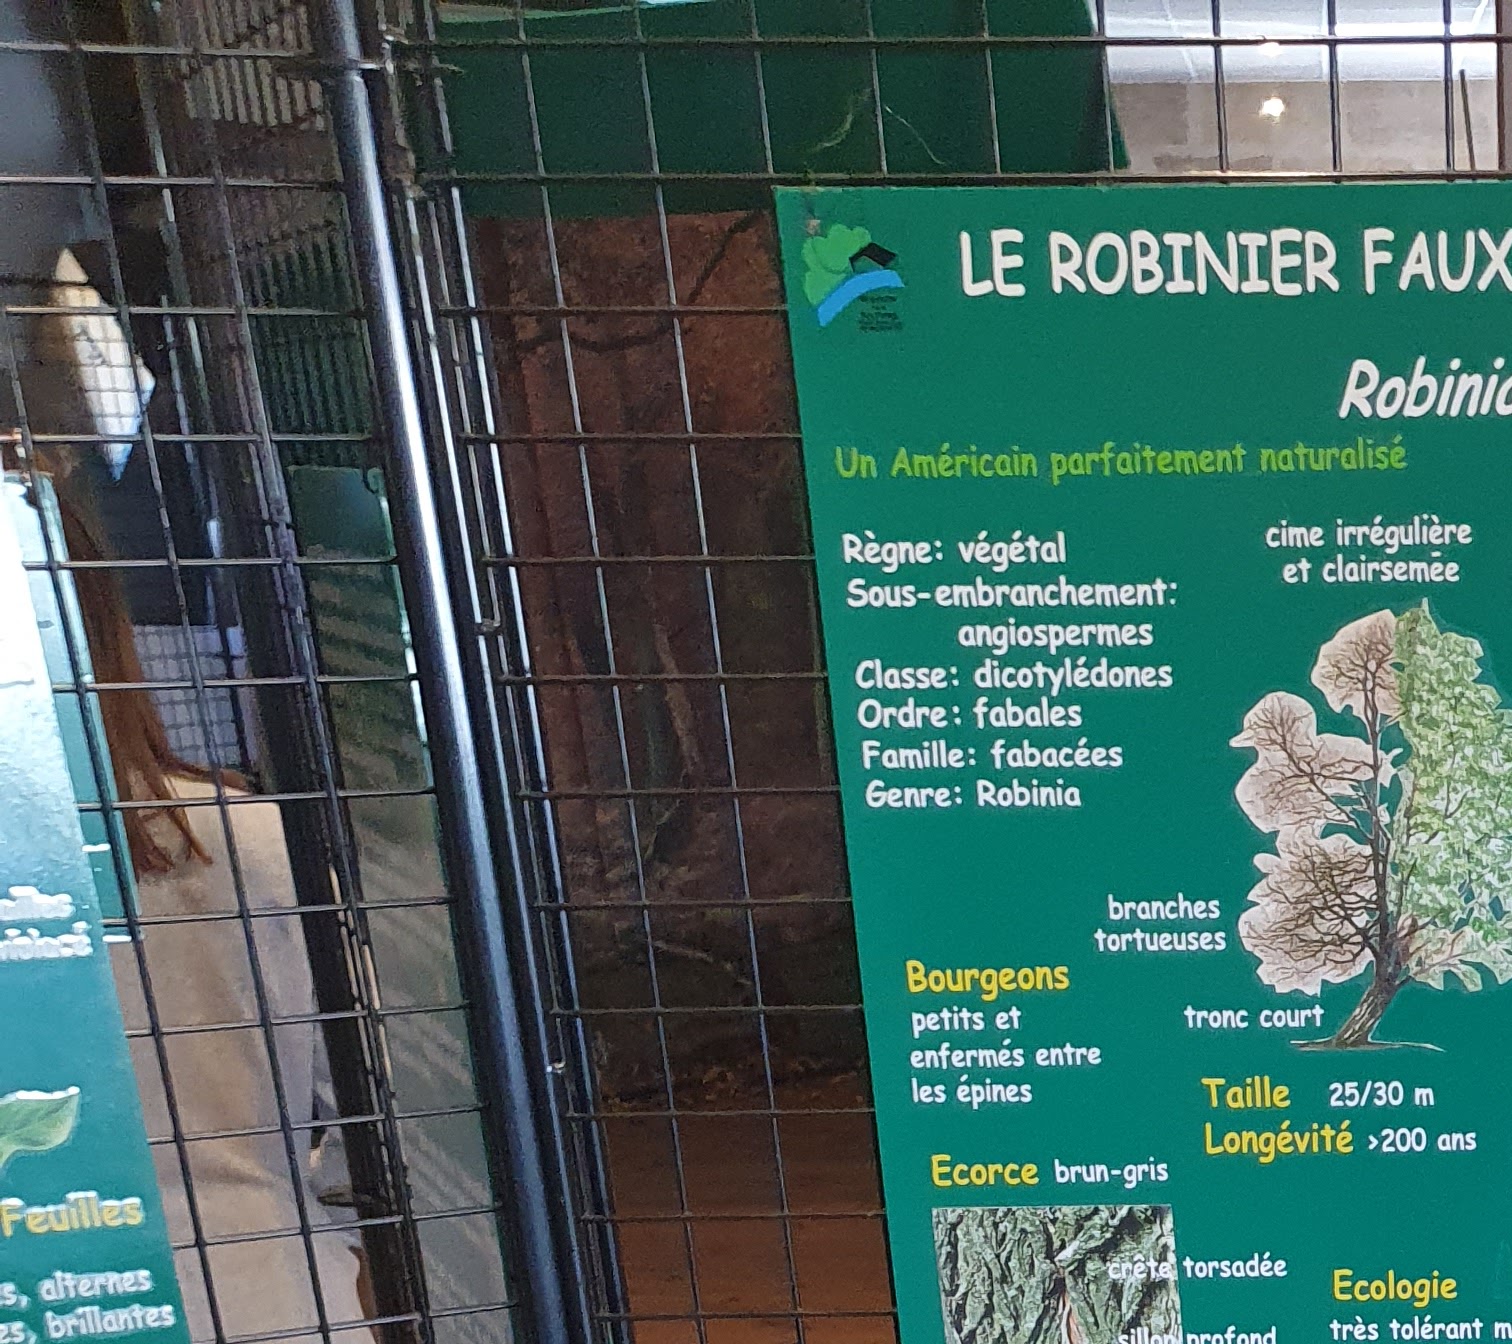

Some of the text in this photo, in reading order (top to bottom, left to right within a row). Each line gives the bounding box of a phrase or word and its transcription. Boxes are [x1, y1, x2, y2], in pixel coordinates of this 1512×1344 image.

[960, 228, 1026, 297] LE
[1049, 227, 1340, 296] ROBINIER
[834, 435, 1408, 486] Un Américain parfaitement naturalisé
[1266, 513, 1472, 551] cime irrégulière
[842, 530, 1067, 573] Règne: végétal
[1282, 551, 1460, 585] et clairsemée
[846, 577, 1177, 608] Sous-embranchement:
[957, 617, 1154, 655] angiospermes
[855, 656, 1174, 696] Classe: dicotylédones
[974, 700, 1082, 729] fabales
[861, 736, 1123, 770] Famille: fabacées
[865, 777, 1081, 808] Genre: Robinia
[1107, 893, 1220, 921] branches
[1094, 927, 1226, 953] tortueuses
[905, 959, 1070, 1002] Bourgeons
[911, 1005, 1022, 1039] petits et
[1183, 1004, 1325, 1030] tronc court
[909, 1038, 1102, 1070] enfermés entre
[911, 1074, 1033, 1110] les épines
[1202, 1075, 1435, 1110] Taille 25/30 m
[1204, 1120, 1476, 1165] Longévité >200 ans
[930, 1153, 1169, 1190] Ecorce brun-gris
[0, 1191, 144, 1237] Feuilles
[1108, 1253, 1288, 1280] crête torsadée
[38, 1269, 153, 1302] alternes
[1331, 1268, 1458, 1308] Ecologie
[45, 1303, 176, 1340] brillantes
[1329, 1318, 1379, 1341] très
[1389, 1315, 1483, 1341] tolérant
